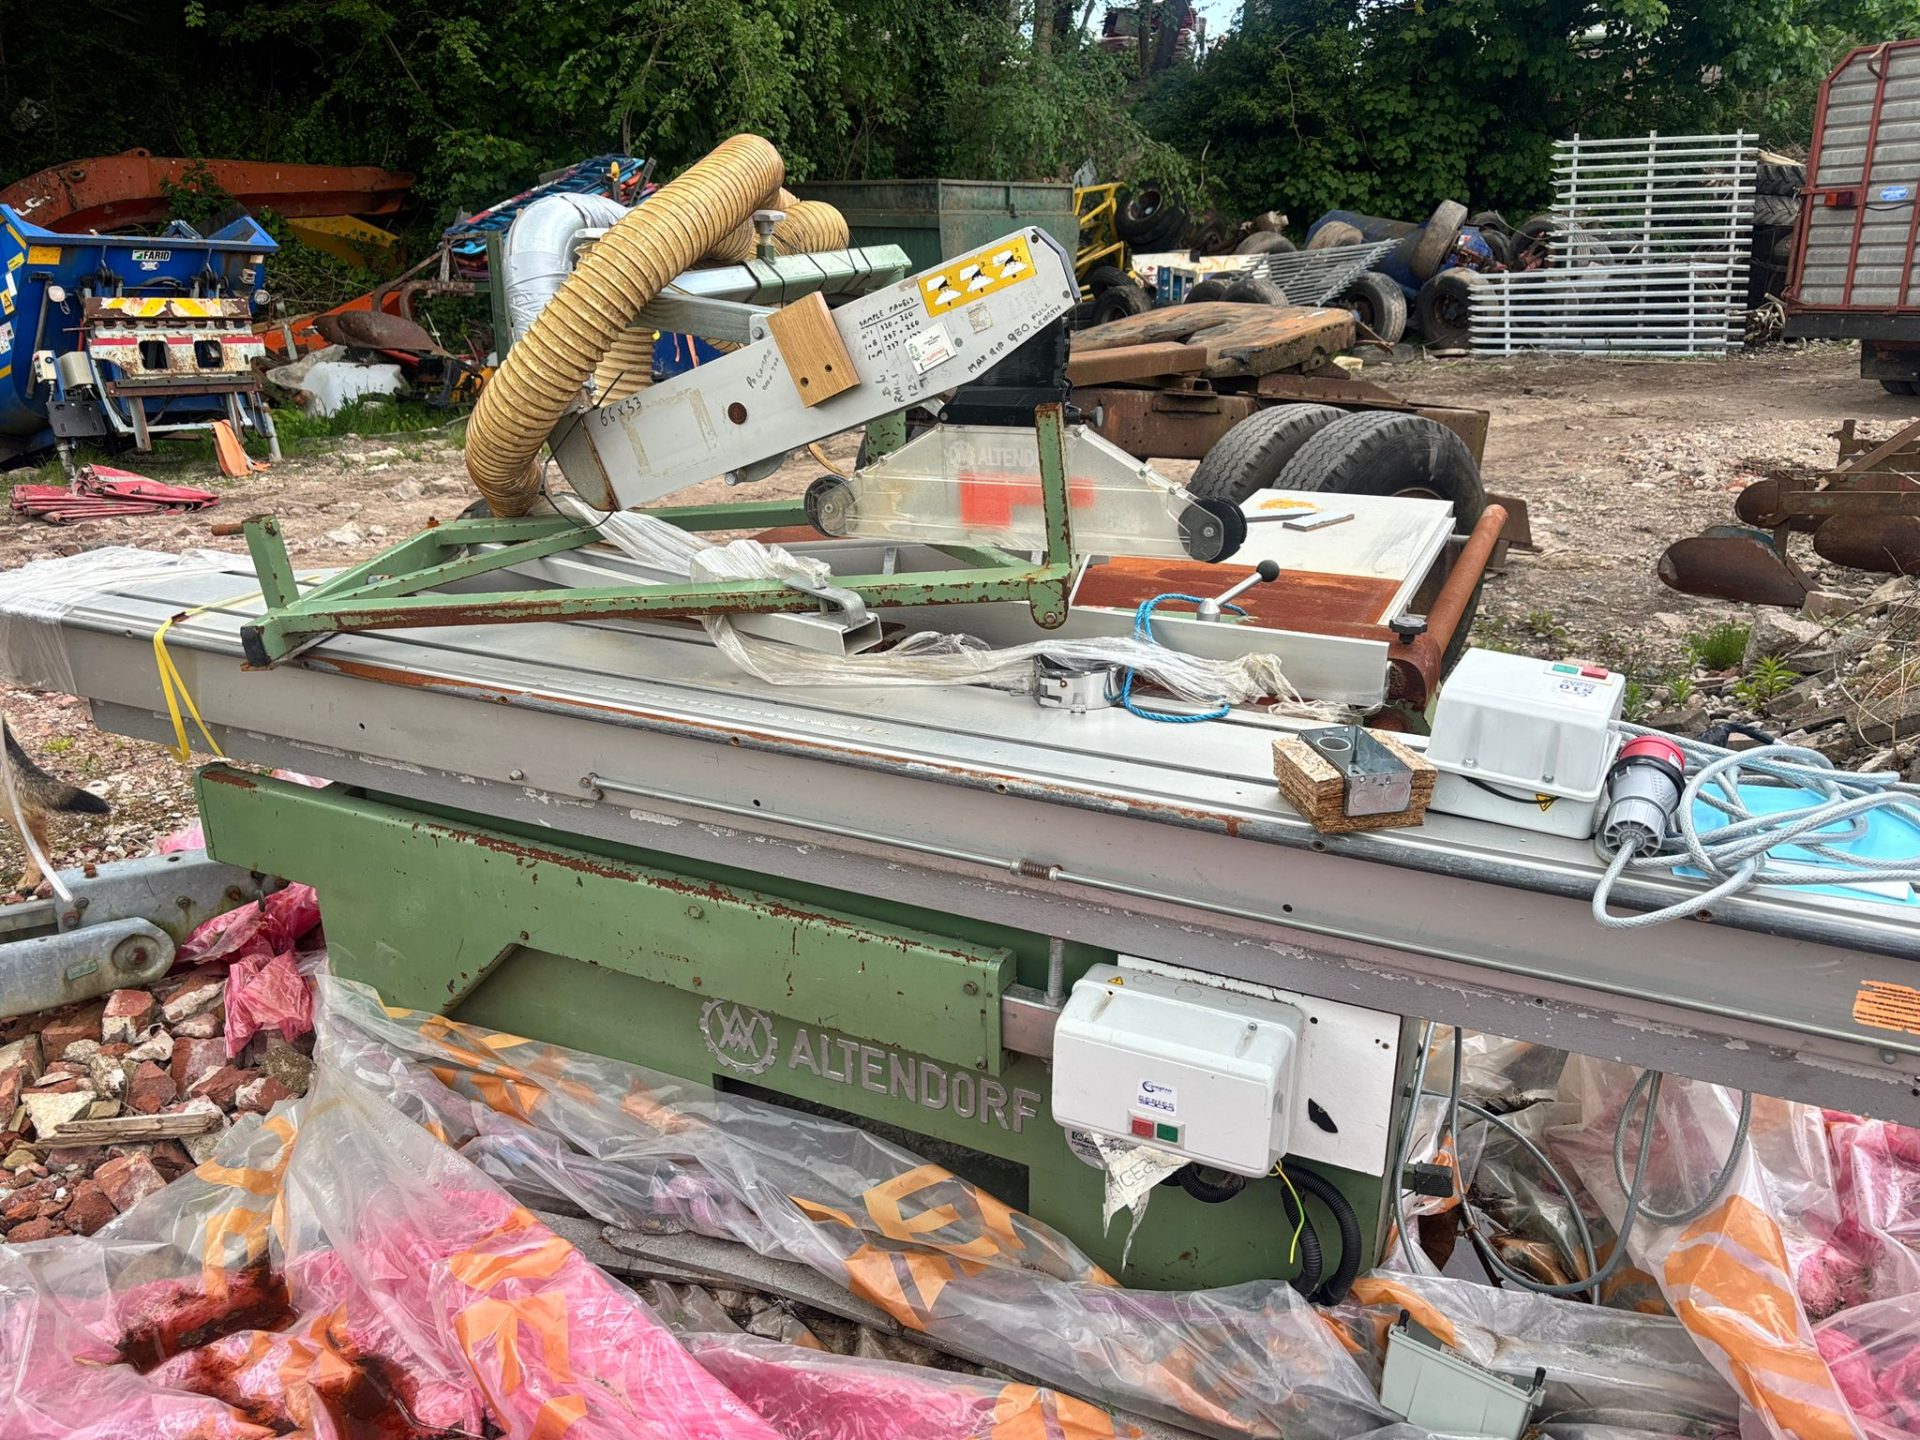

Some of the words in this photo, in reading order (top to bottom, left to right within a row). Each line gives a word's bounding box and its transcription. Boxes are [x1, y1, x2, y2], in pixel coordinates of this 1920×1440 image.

[143, 250, 170, 260] FARID
[859, 310, 884, 327] SAMPLE
[889, 297, 914, 313] PANELS
[1031, 303, 1052, 320] FULL
[1033, 305, 1062, 329] LENGTH
[968, 355, 987, 373] MAX
[788, 1028, 1042, 1134] ALTENDORF
